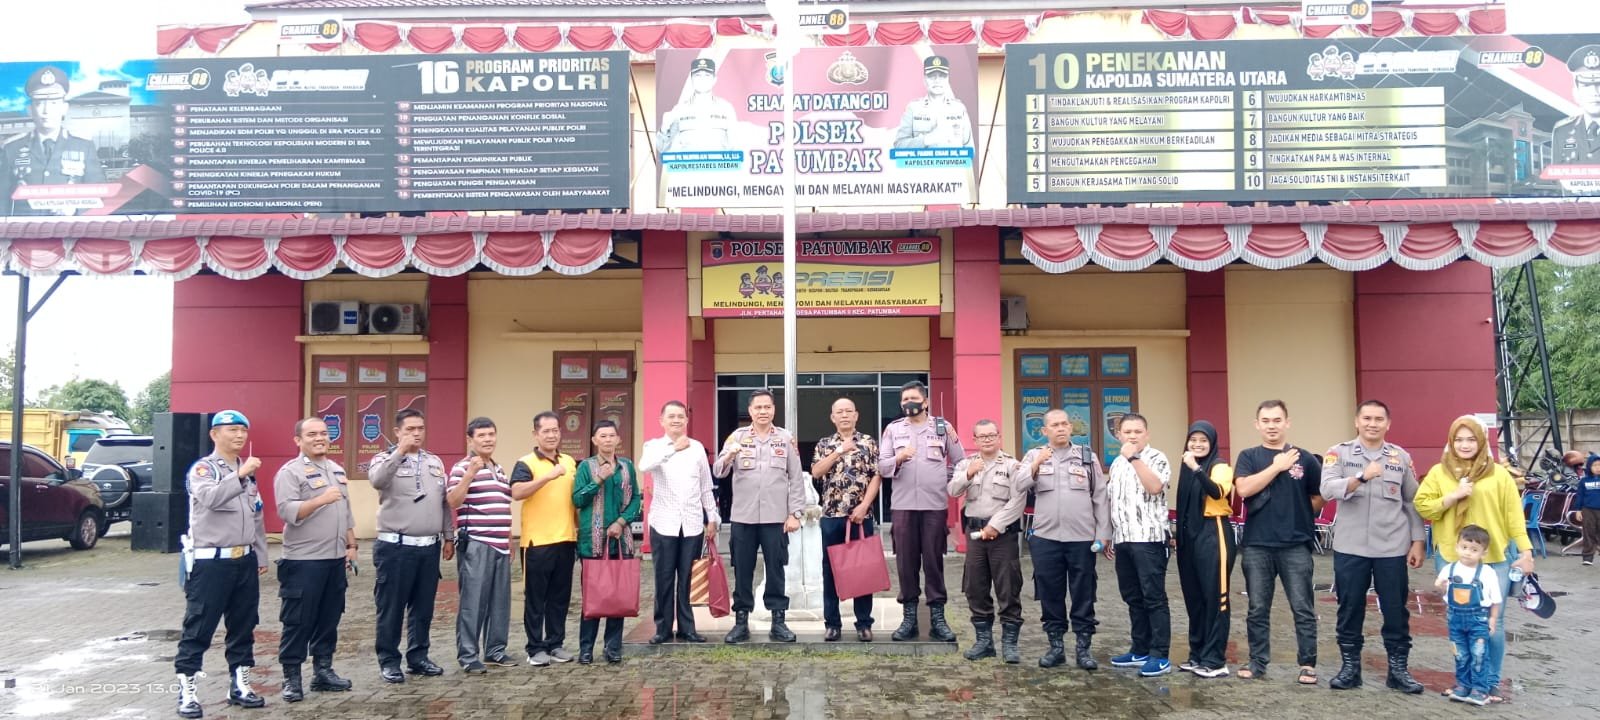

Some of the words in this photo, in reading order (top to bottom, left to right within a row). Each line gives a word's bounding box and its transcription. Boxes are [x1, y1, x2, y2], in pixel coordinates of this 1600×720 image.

[1306, 4, 1348, 16] CHANNEL
[1351, 4, 1368, 16] 88
[830, 13, 844, 26] 88
[281, 25, 320, 36] CHANNEL
[323, 23, 338, 35] 88
[1086, 51, 1225, 72] PENEKANAN
[1480, 52, 1524, 64] CHANNEL
[1526, 50, 1542, 64] 88
[466, 59, 534, 74] PROGRAM
[539, 58, 610, 72] PRIORITAS
[1028, 53, 1080, 90] 10
[190, 69, 208, 84] 88
[418, 61, 460, 94] 16
[465, 74, 609, 93] KAPOLRI
[1086, 72, 1150, 89] KAPOLDA
[1157, 71, 1235, 88] SUMATERA
[1240, 71, 1287, 85] UTARA
[812, 93, 871, 111] DATANG
[872, 93, 888, 110] DI
[1032, 98, 1037, 108] 1
[1051, 97, 1104, 107] TINDAKLANJUTI
[1113, 96, 1162, 106] REALISASIKAN
[1165, 95, 1198, 105] PROGRAM
[1200, 95, 1229, 104] KAPOLRI
[1249, 94, 1255, 105] 6
[1268, 93, 1307, 103] WUJUDKAN
[1310, 92, 1365, 101] HARKAMTIBMAS
[1032, 118, 1039, 129] 2
[1051, 117, 1079, 127] BANGUN
[1081, 117, 1108, 126] KULTUR
[1110, 116, 1128, 126] YANG
[1130, 116, 1163, 125] MELAYANI
[1250, 114, 1256, 125] 7
[1268, 114, 1297, 123] BANGUN
[1299, 113, 1326, 122] KULTUR
[1328, 113, 1347, 121] YANG
[1349, 112, 1365, 120] BAIK
[1032, 138, 1039, 149] 3
[1052, 137, 1090, 146] WUJUDKAN
[1092, 137, 1138, 145] PENEGAKKAN
[1140, 136, 1165, 145] HUKUM
[1167, 135, 1215, 145] BERKEADILAN
[1250, 134, 1256, 145] 8
[1269, 133, 1300, 142] JADIKAN
[1302, 133, 1323, 141] MEDIA
[1325, 132, 1355, 141] SEBAGAI
[1357, 131, 1378, 140] MITRA
[1381, 130, 1417, 140] STRATEGIS
[750, 149, 882, 174] PAUMBAK
[1032, 159, 1039, 169] 4
[1051, 157, 1108, 166] MENGUTAMAKAN
[1111, 156, 1156, 165] PENCEGAHAN
[1250, 154, 1256, 166] 9
[1270, 153, 1314, 163] TINGKATKAN
[1316, 153, 1331, 162] PAM
[1339, 152, 1355, 161] WAS
[1357, 152, 1391, 161] INTERNAL
[1032, 179, 1039, 189] 5
[1051, 177, 1079, 186] BANGUN
[1081, 177, 1123, 186] KERJASAMA
[1125, 177, 1135, 185] TIM
[1137, 176, 1157, 185] YANG
[1159, 176, 1179, 185] SOLID
[1247, 175, 1260, 187] 10
[1271, 175, 1288, 184] JAGA
[1289, 174, 1325, 184] SOLIDITAS
[1326, 174, 1339, 183] TNI
[1347, 173, 1378, 182] INSTANSI
[1380, 172, 1410, 182] TERKAIT
[809, 184, 829, 195] DAN
[833, 184, 884, 194] MELAYANI
[731, 242, 798, 256] POLSE
[802, 241, 892, 256] PATUMBAK
[795, 271, 895, 287] PRESISI
